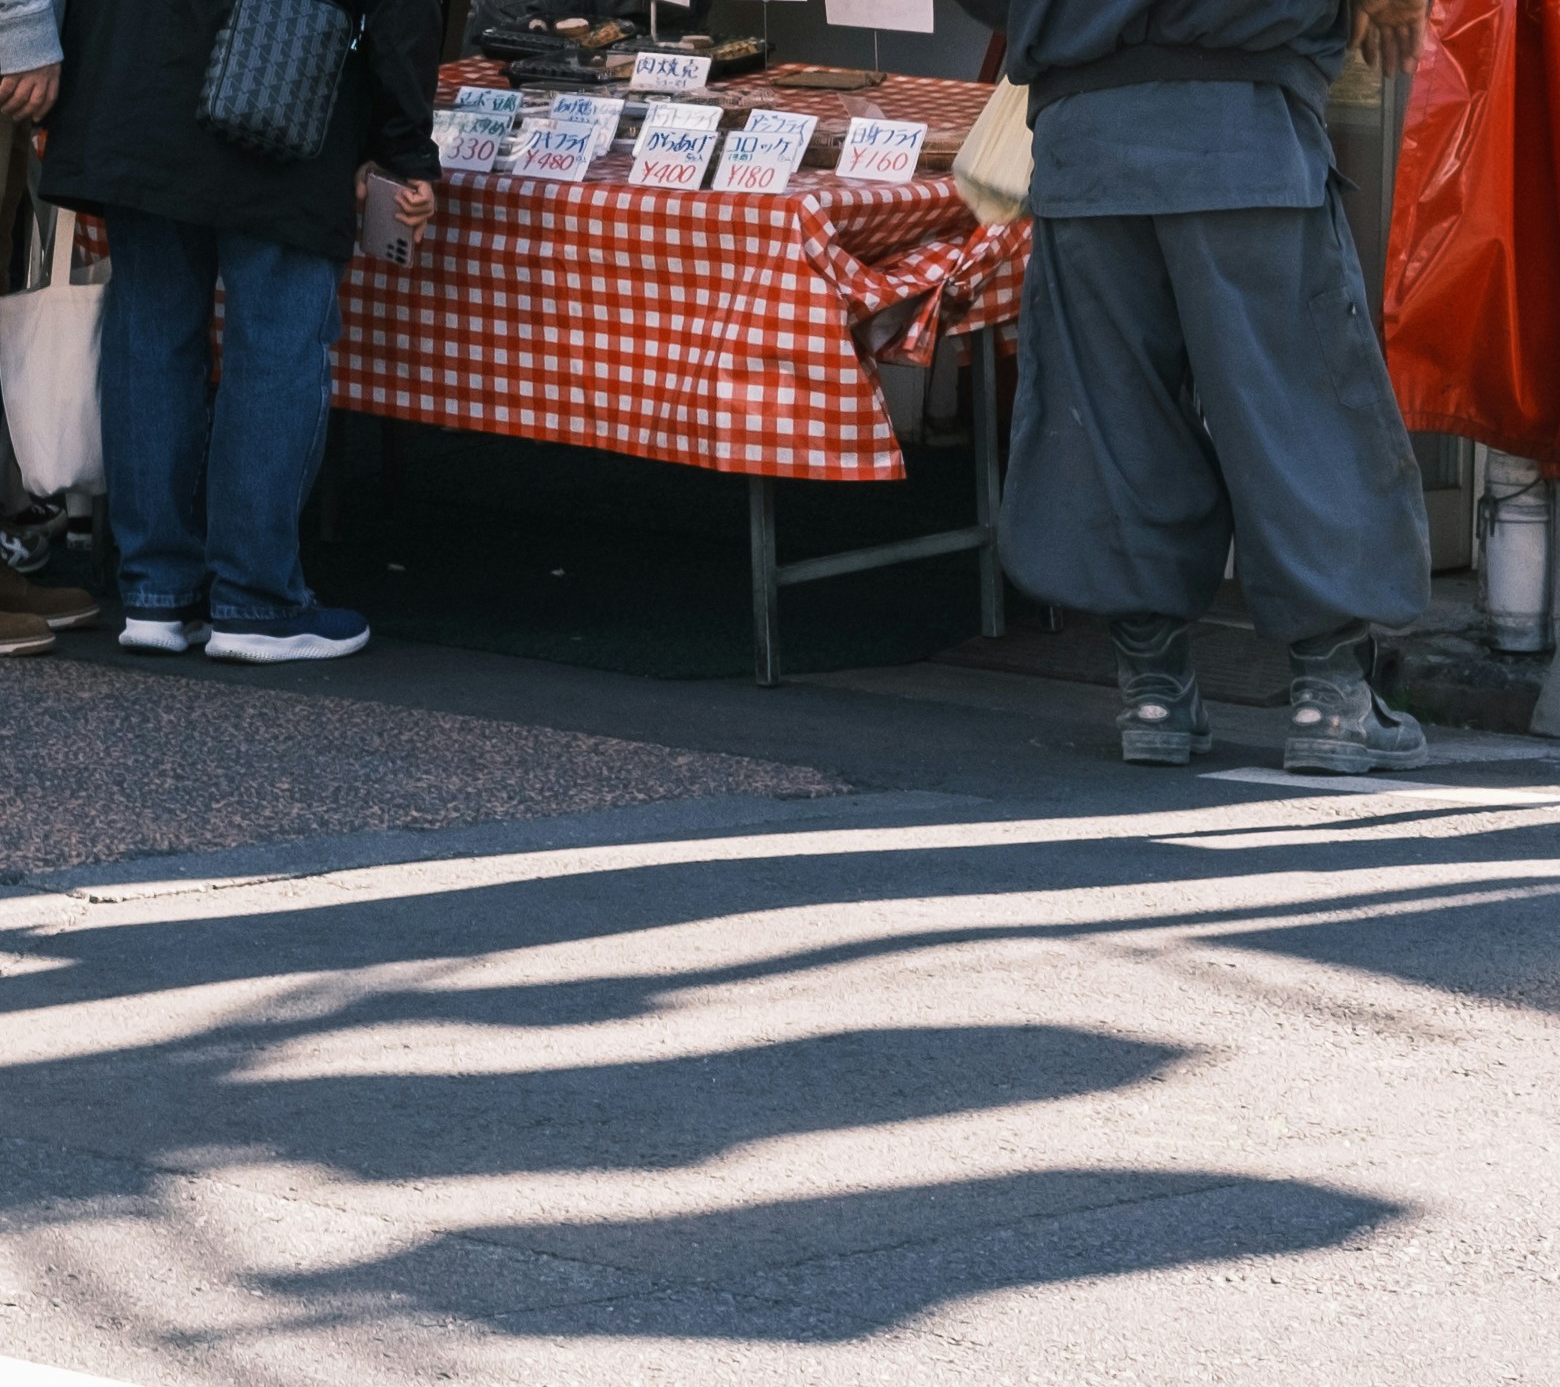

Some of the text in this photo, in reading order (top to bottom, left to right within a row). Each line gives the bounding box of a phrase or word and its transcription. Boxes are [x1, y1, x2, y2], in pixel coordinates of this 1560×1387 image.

[726, 137, 793, 155] コロッケ
[850, 123, 923, 150] 白身フライ
[522, 148, 575, 172] ¥480
[849, 146, 909, 173] ¥160
[641, 160, 697, 186] ¥400
[726, 164, 775, 189] ¥180
